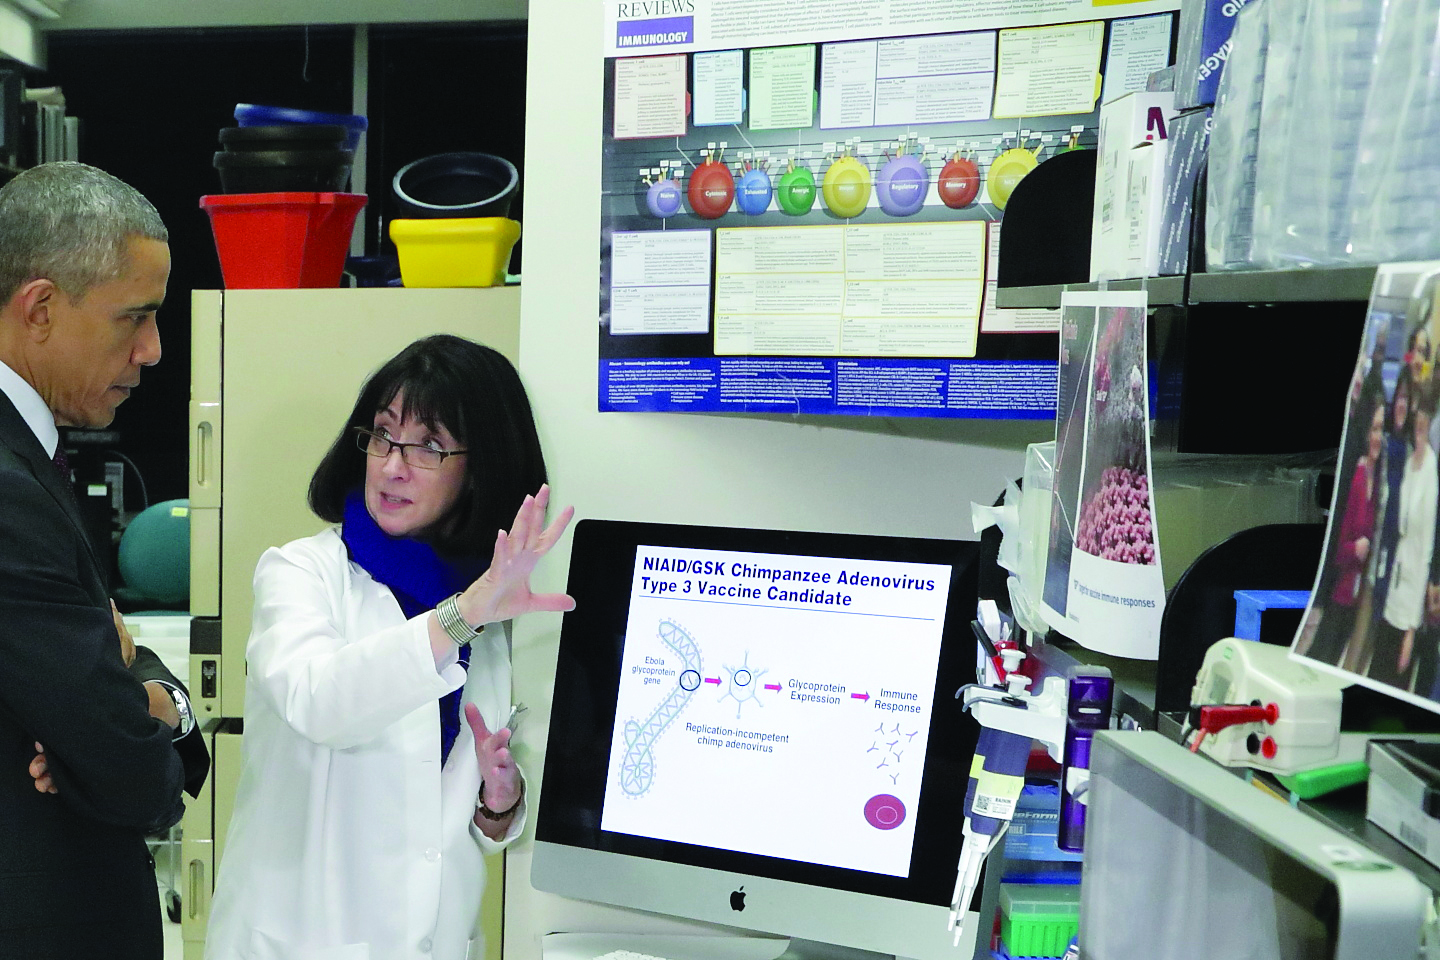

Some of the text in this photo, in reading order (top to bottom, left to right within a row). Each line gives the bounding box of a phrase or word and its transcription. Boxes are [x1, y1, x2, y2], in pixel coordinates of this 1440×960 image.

[618, 0, 695, 18] REVIEWS
[618, 31, 688, 46] IMMUNOLOGY
[643, 557, 935, 591] NIAID/GSK Chimpanzee Adenovirus
[641, 577, 852, 606] Type 3 Vaccine Candidate
[1120, 597, 1156, 608] responses
[645, 656, 665, 666] Ebola
[632, 664, 676, 678] glycoprotein
[644, 676, 661, 686] gene
[788, 678, 846, 694] Glycoprotein
[790, 691, 841, 705] Expression
[880, 687, 918, 701] Immune
[874, 699, 921, 714] Response
[685, 723, 789, 743] Replication-incompetent
[697, 735, 773, 753] chimp adenovirus
